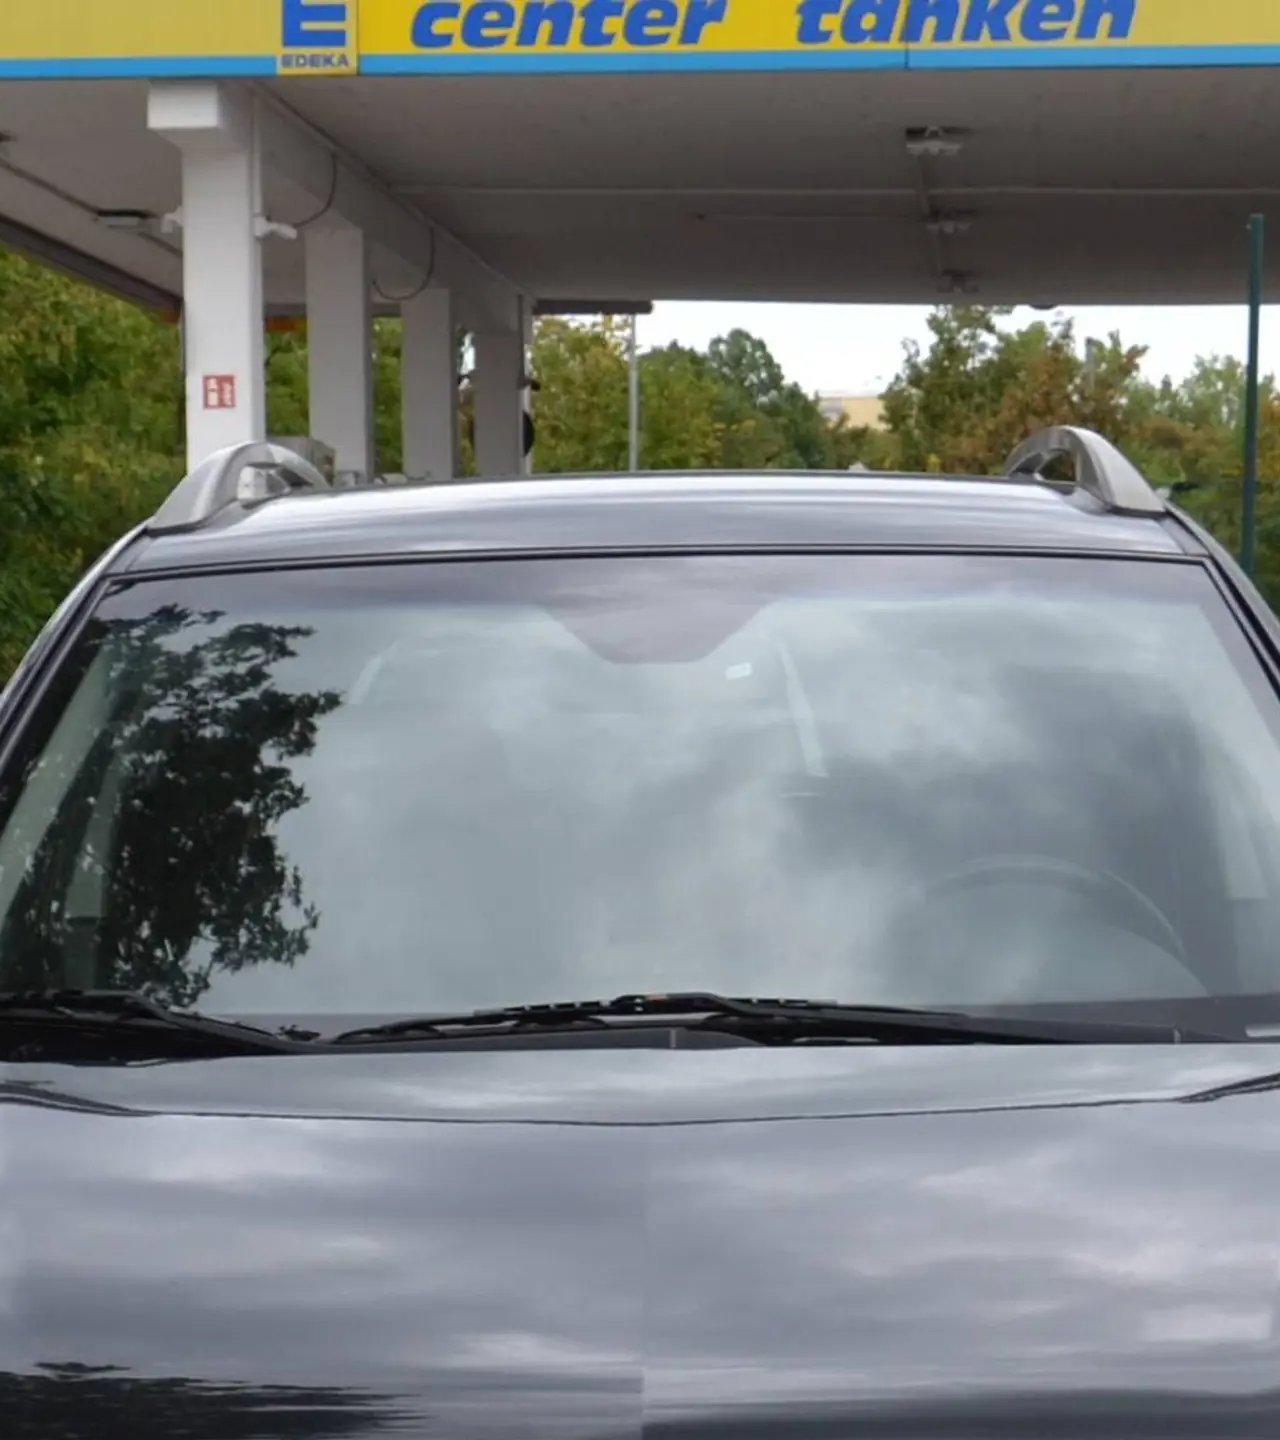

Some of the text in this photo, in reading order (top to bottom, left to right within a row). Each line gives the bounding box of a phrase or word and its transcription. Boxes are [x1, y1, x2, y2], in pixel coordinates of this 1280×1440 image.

[409, 0, 1136, 48] center tanken
[281, 53, 349, 68] EDEKA
